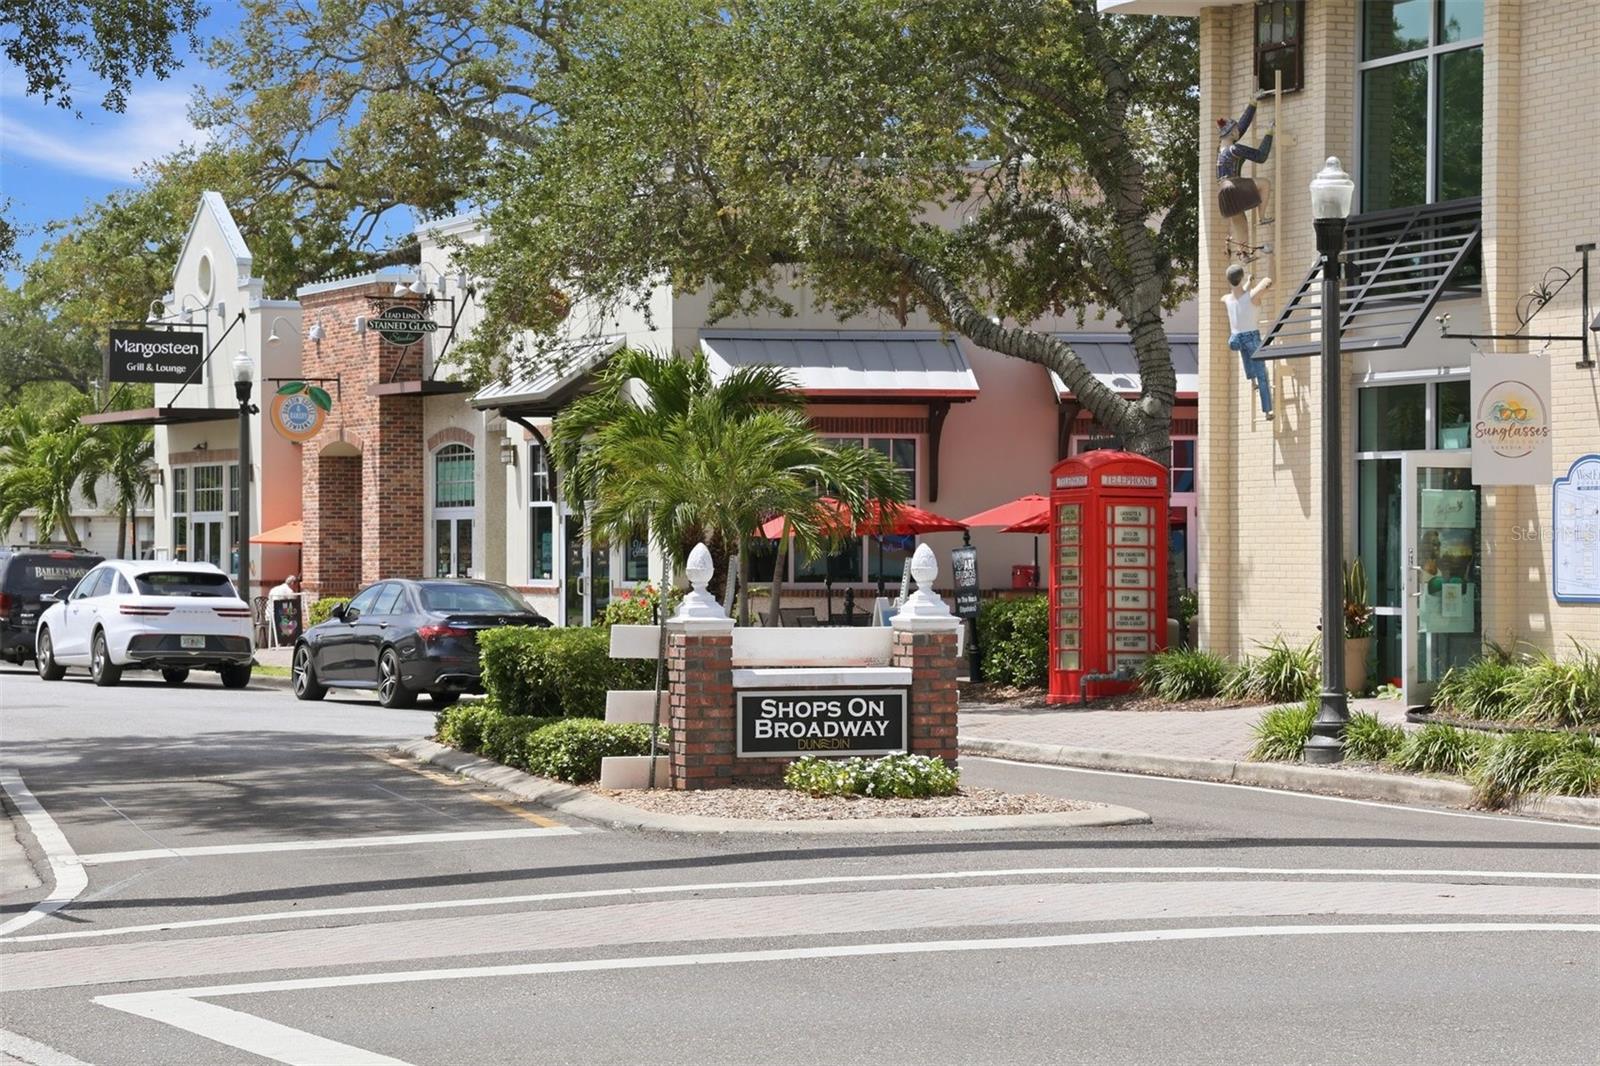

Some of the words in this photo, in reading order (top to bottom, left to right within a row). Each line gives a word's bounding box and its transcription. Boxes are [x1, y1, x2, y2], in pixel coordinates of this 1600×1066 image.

[368, 320, 407, 330] STAINED
[408, 321, 437, 331] GLASS
[115, 339, 199, 358] Mangosteen
[126, 362, 145, 372] Grill
[146, 363, 154, 372] &
[156, 363, 187, 374] Lounge
[1475, 421, 1551, 441] Sunglasses
[1104, 476, 1154, 486] TELEPHONE
[760, 699, 842, 719] SHOPS
[847, 697, 885, 718] ON
[755, 719, 890, 739] BROADWAY
[797, 738, 850, 750] DUNEDIN
